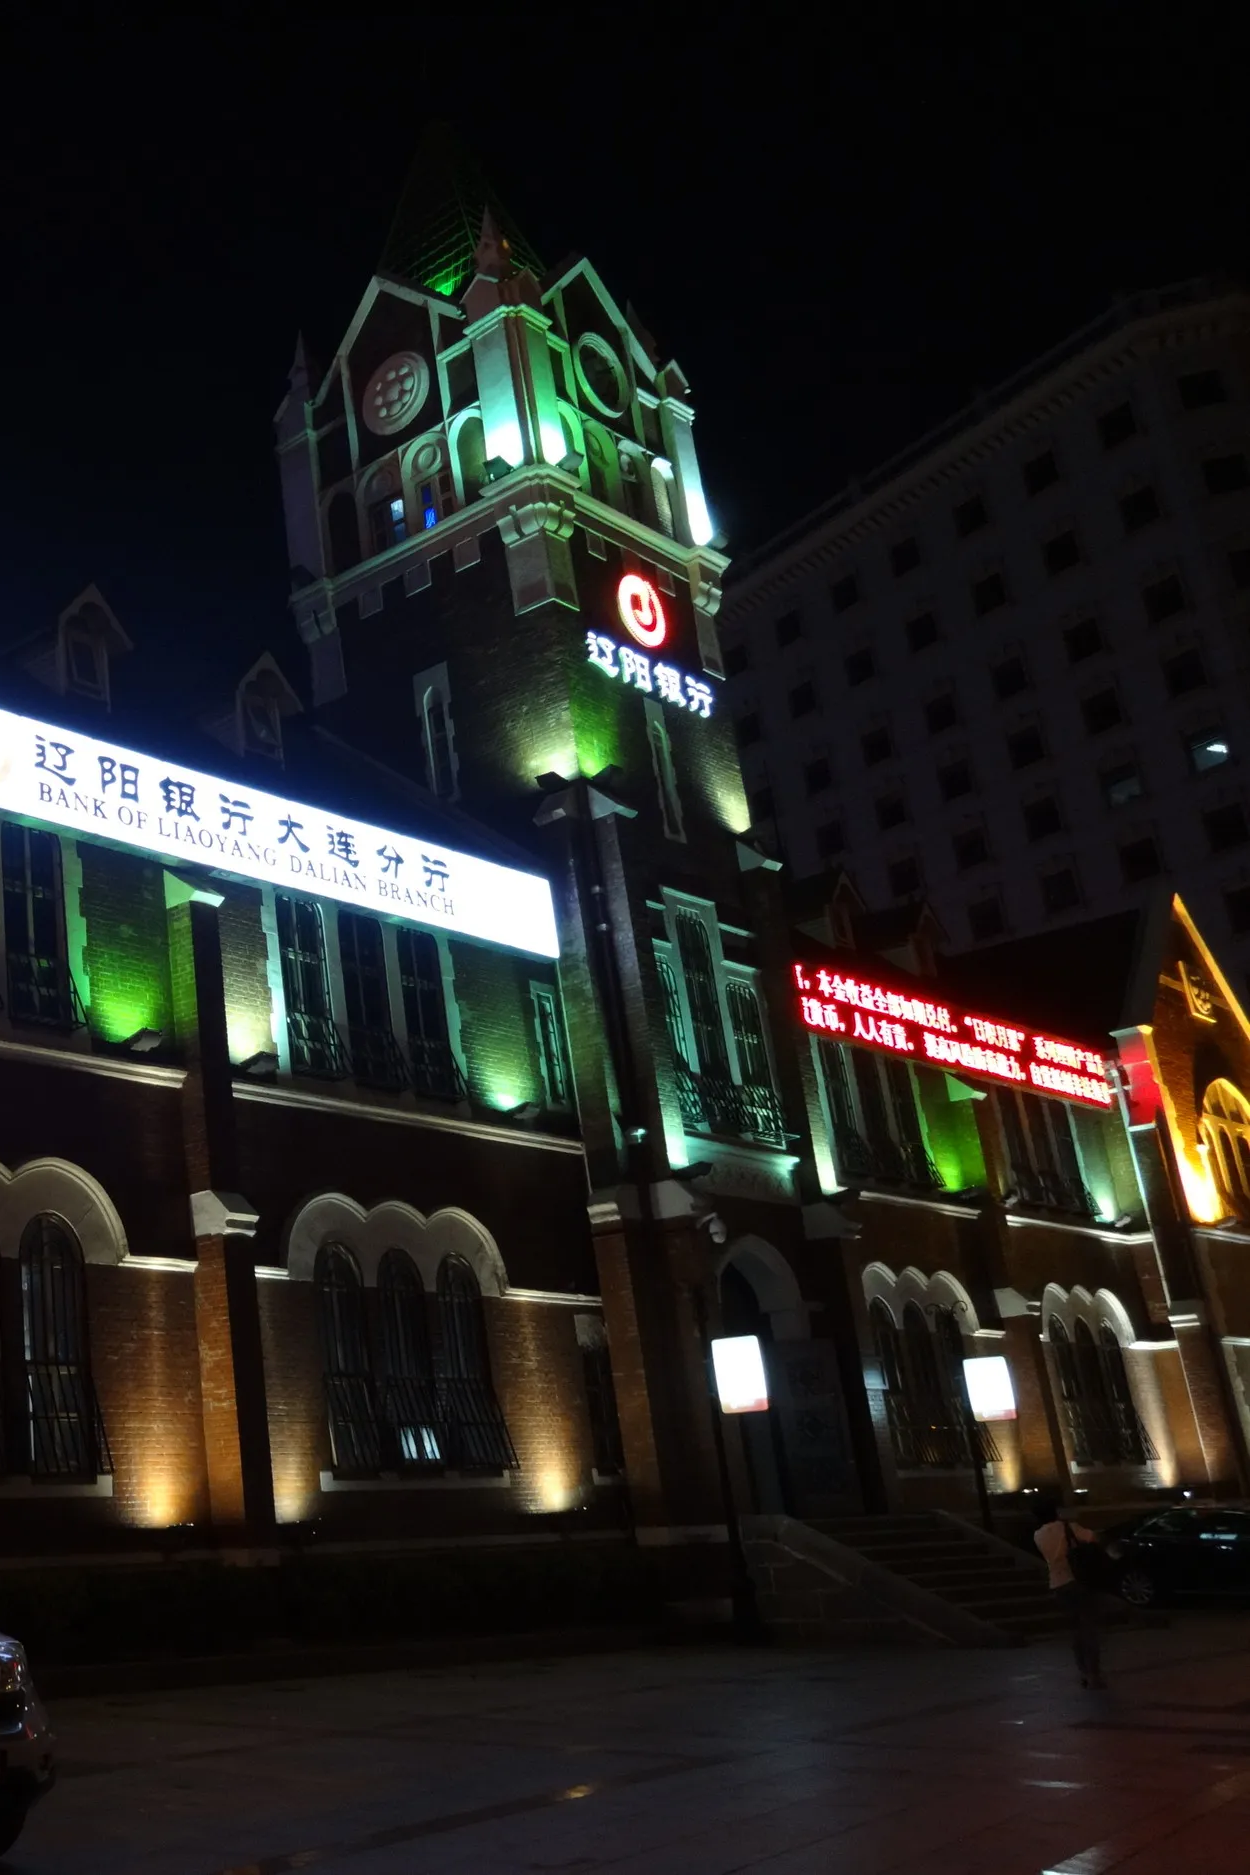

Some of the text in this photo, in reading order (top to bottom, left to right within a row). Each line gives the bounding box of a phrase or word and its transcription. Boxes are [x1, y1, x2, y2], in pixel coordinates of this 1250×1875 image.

[585, 631, 714, 719] 辽阳银行
[34, 734, 450, 892] 辽阳银行大连分行
[38, 782, 456, 917] BANK OF LIAOYANG DALIAN BRANCH
